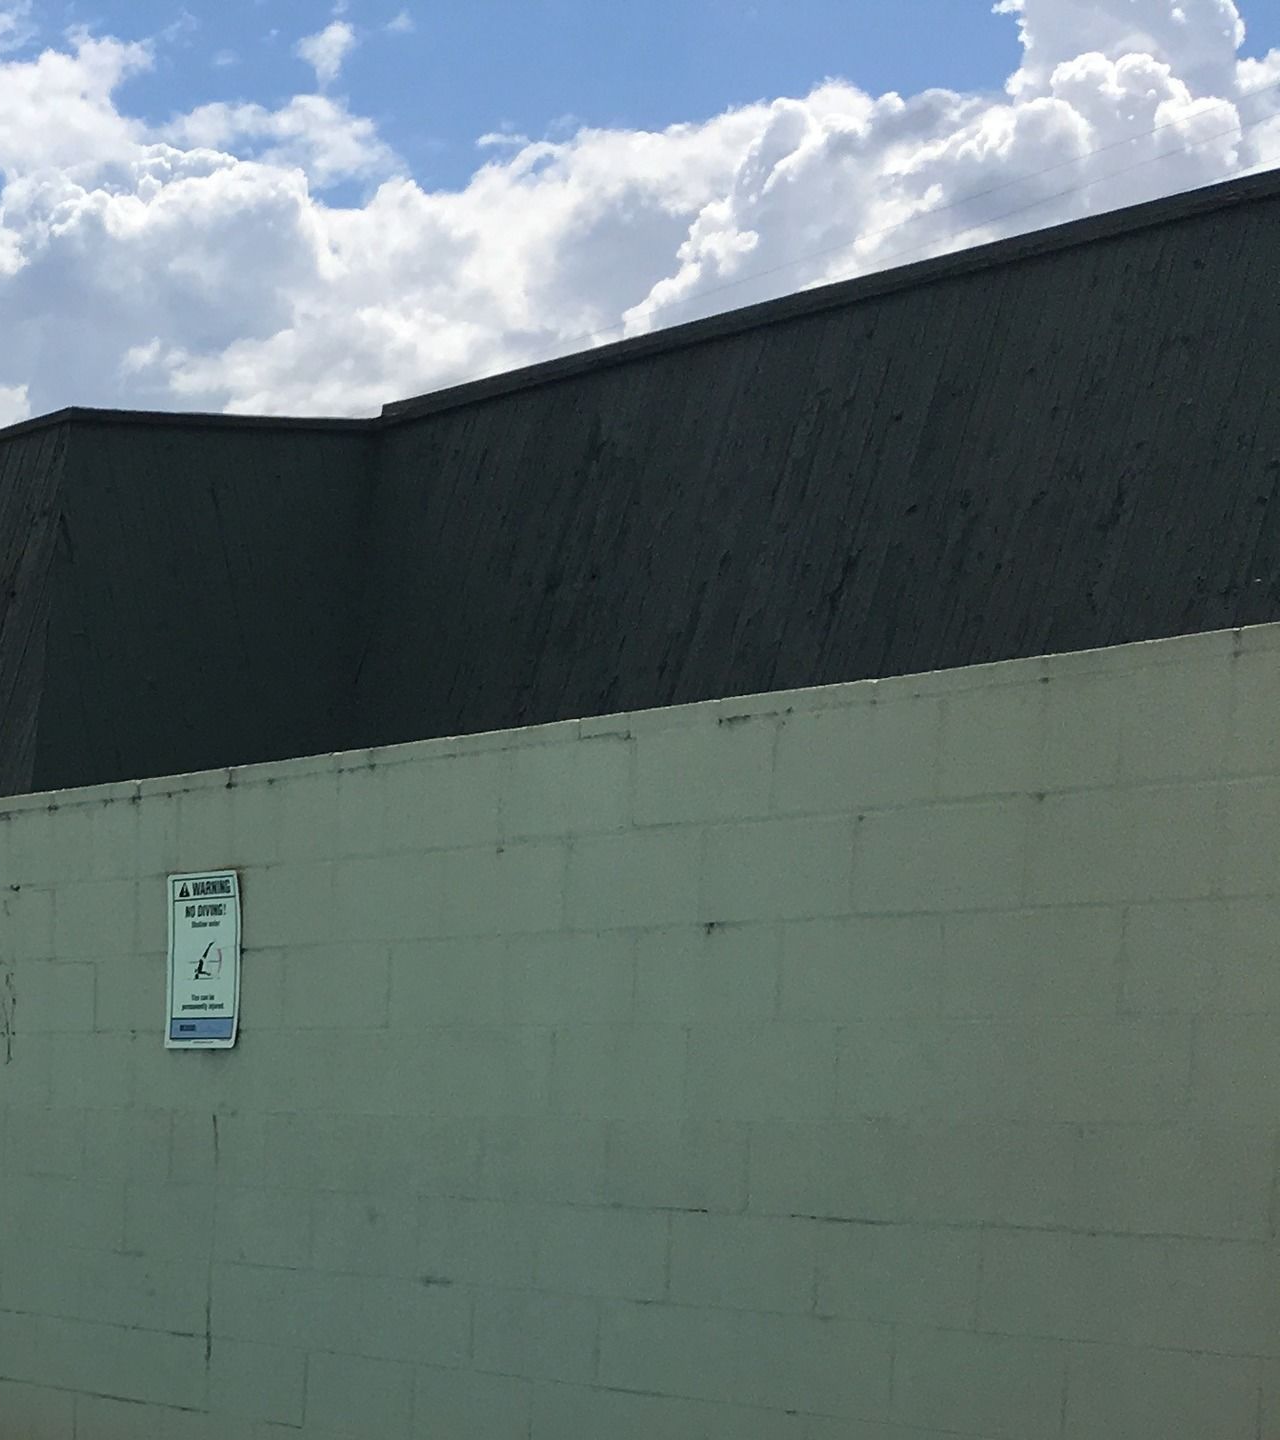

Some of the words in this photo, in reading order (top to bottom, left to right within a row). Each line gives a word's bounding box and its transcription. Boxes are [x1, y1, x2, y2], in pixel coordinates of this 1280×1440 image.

[192, 879, 231, 896] WARNING
[185, 905, 196, 918] NO
[197, 903, 226, 917] DIVING!
